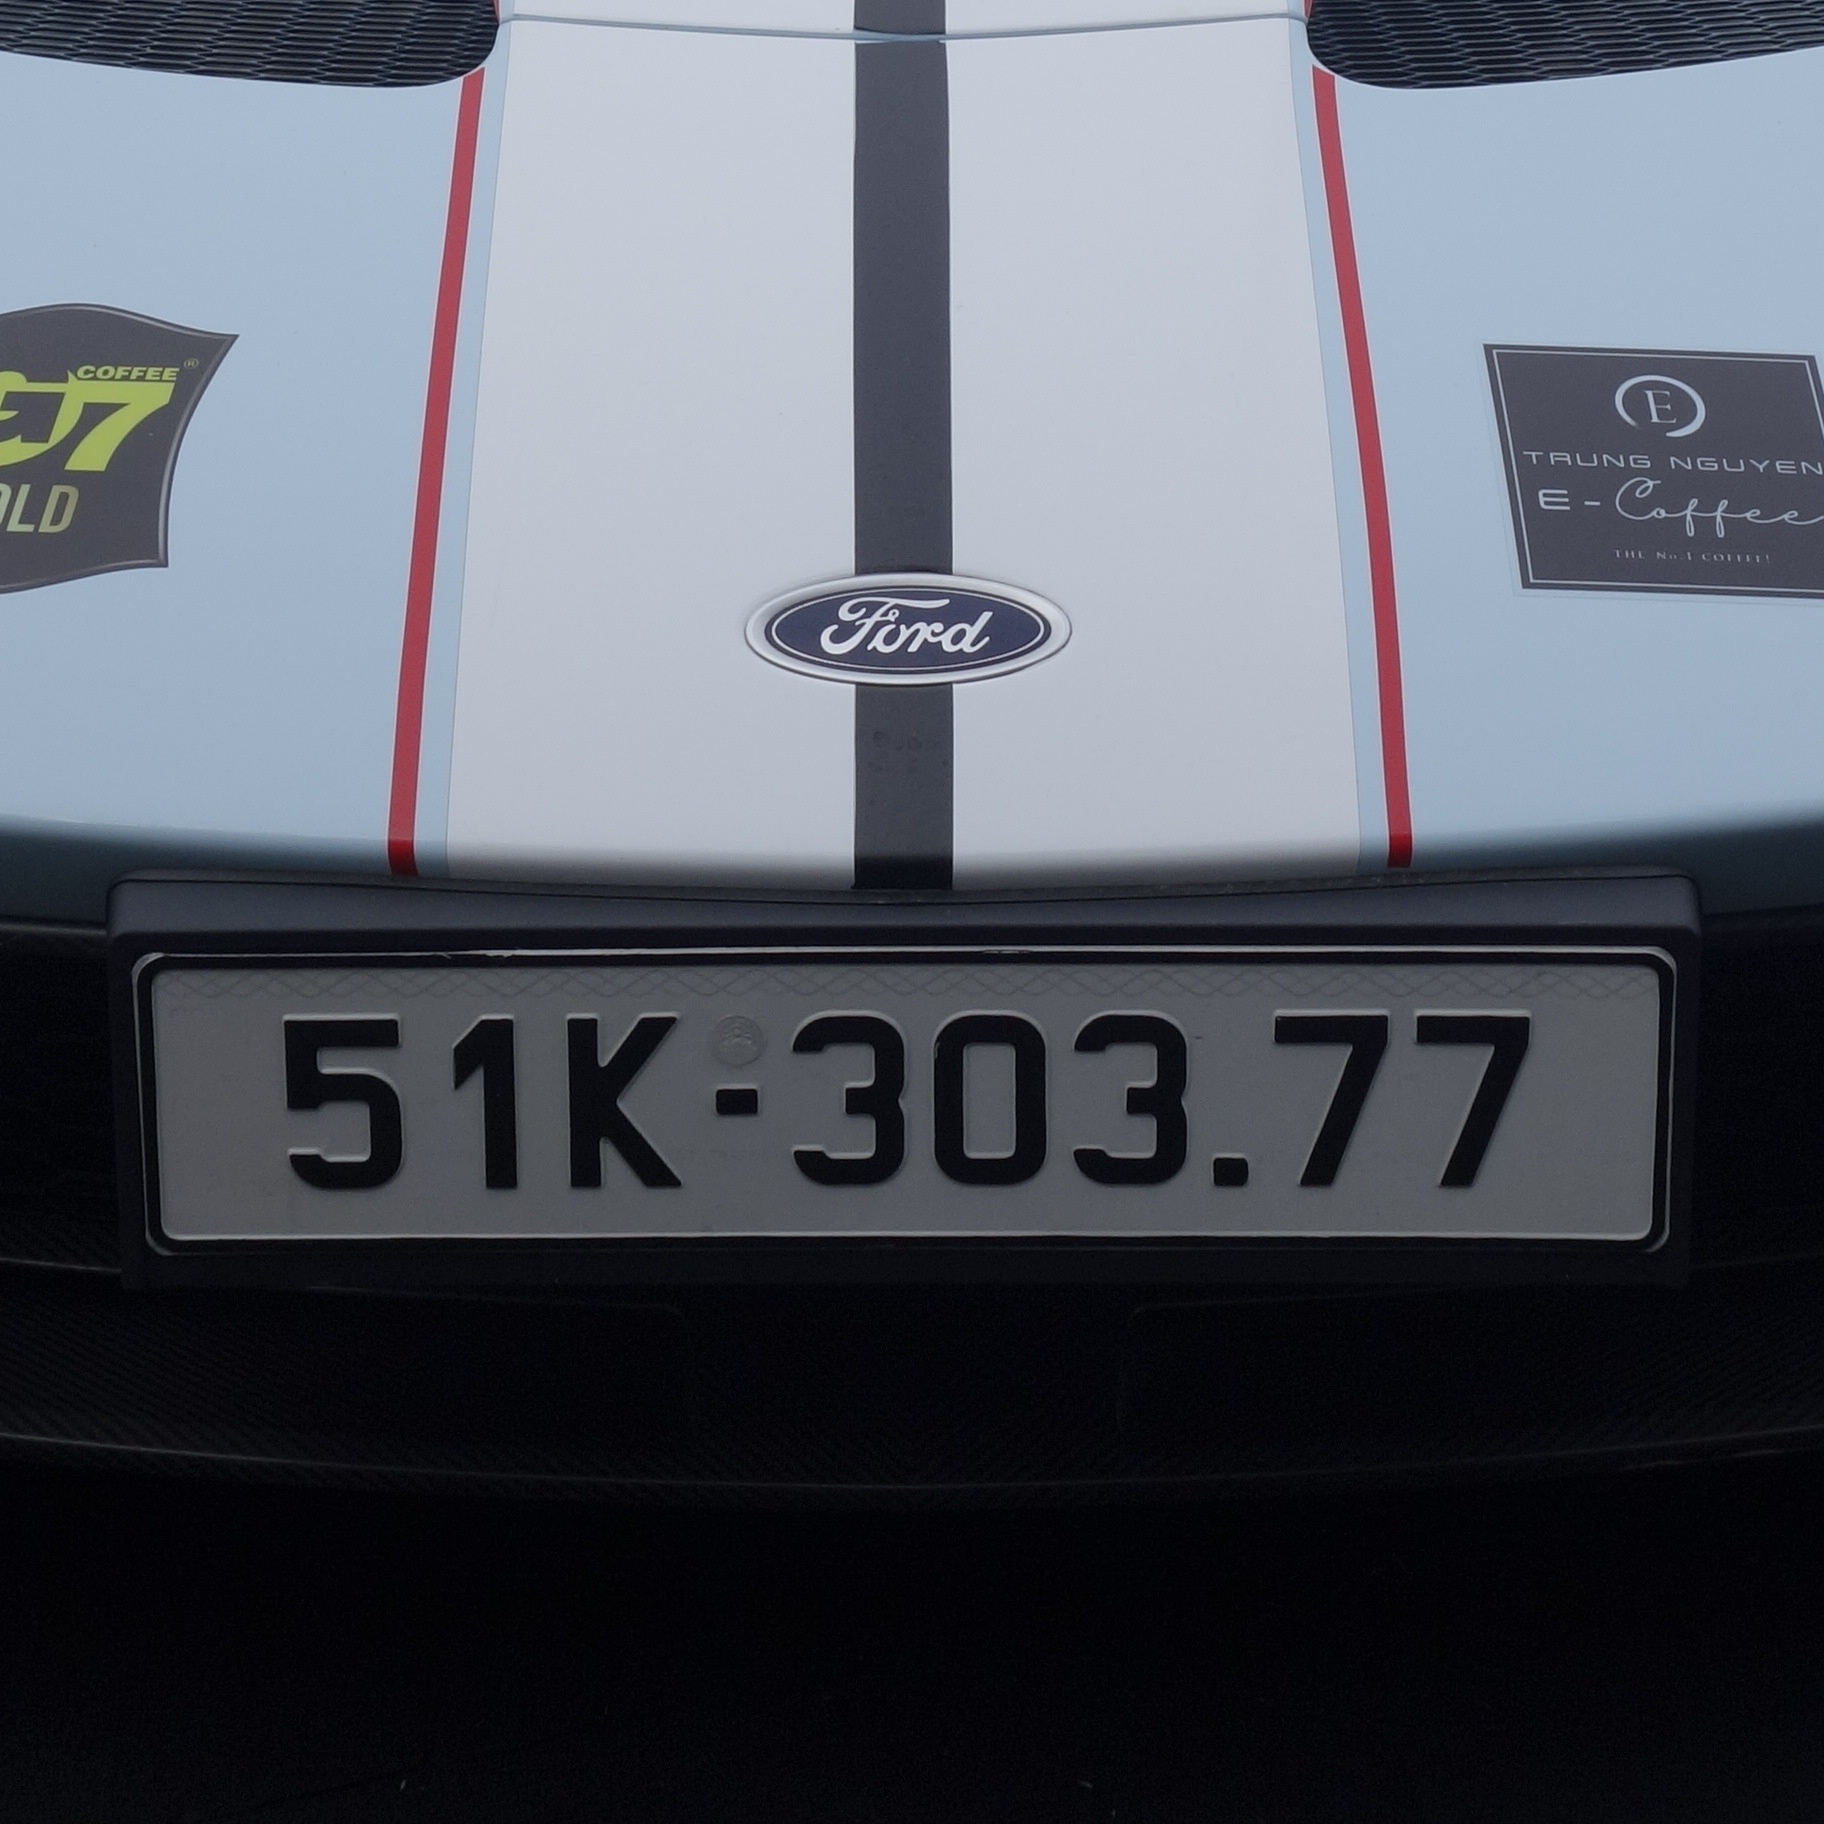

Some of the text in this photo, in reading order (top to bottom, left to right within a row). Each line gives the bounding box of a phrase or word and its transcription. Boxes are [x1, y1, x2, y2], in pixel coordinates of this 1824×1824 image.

[76, 364, 181, 382] COFFEE
[1522, 450, 1824, 476] TRUNG NGUYEN
[819, 595, 994, 655] Ford
[282, 1013, 1531, 1189] 51K-303.77
